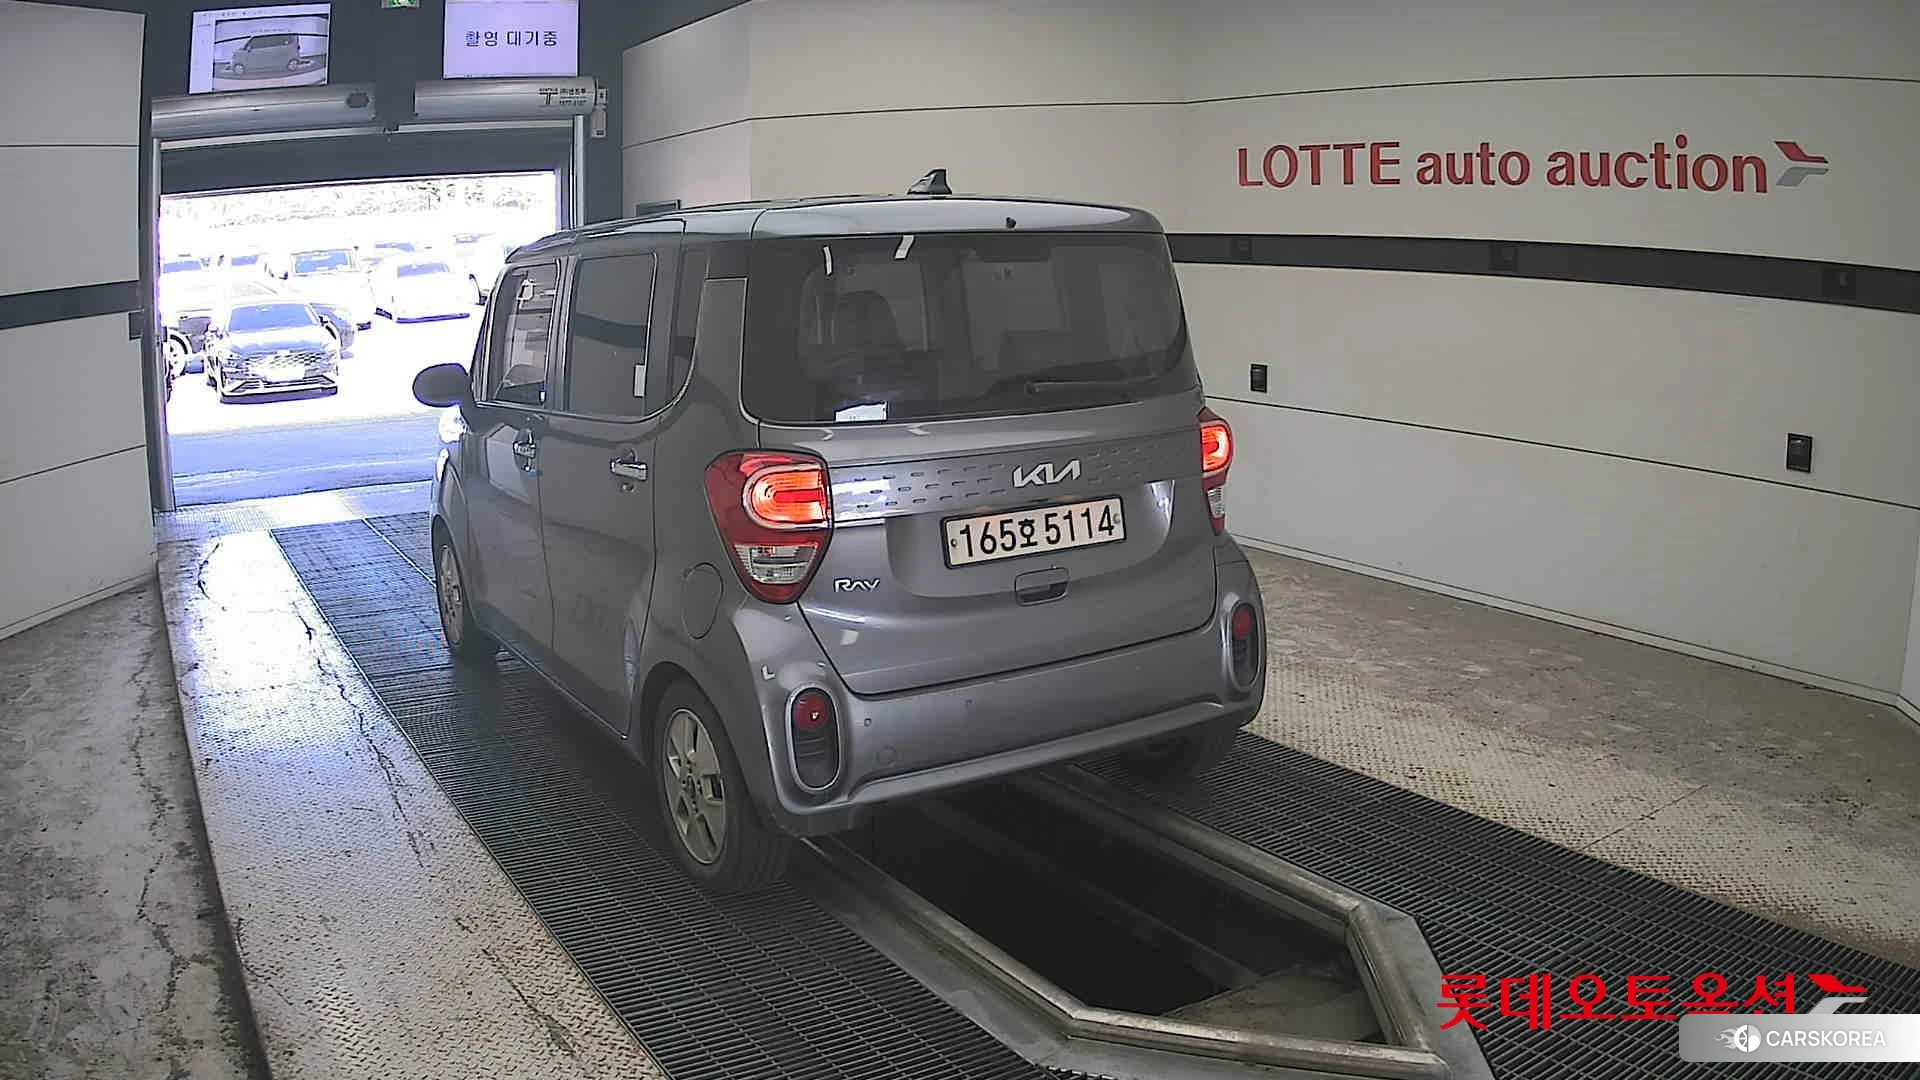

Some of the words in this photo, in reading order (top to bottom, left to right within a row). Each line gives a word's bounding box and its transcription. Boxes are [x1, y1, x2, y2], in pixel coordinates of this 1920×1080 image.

[506, 30, 557, 47] 대기중
[1237, 141, 1400, 188] LOTTE
[1416, 141, 1531, 187] auto
[1546, 134, 1768, 194] auction
[1012, 459, 1081, 488] KIA
